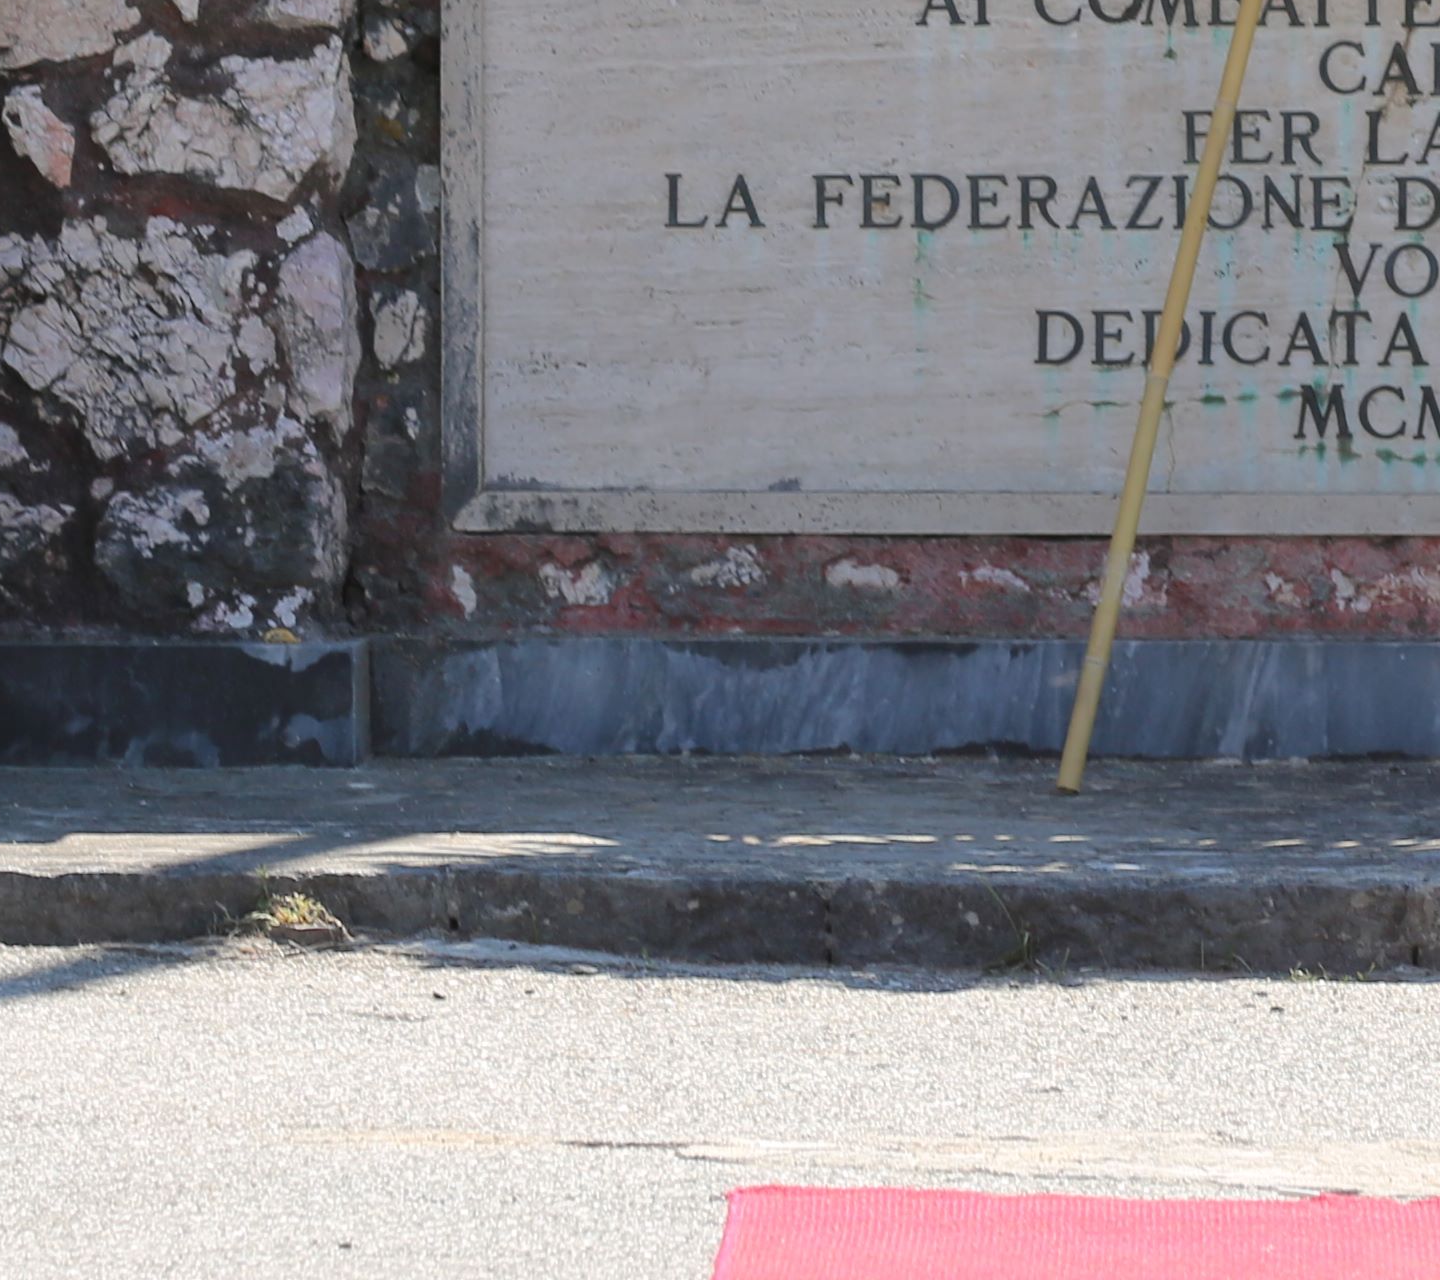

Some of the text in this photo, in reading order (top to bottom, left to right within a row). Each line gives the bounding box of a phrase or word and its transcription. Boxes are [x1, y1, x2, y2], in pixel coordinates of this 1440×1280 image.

[664, 173, 766, 229] LA
[812, 173, 1356, 233] FEDERAZIONE
[1033, 309, 1430, 366] DEDICATA
